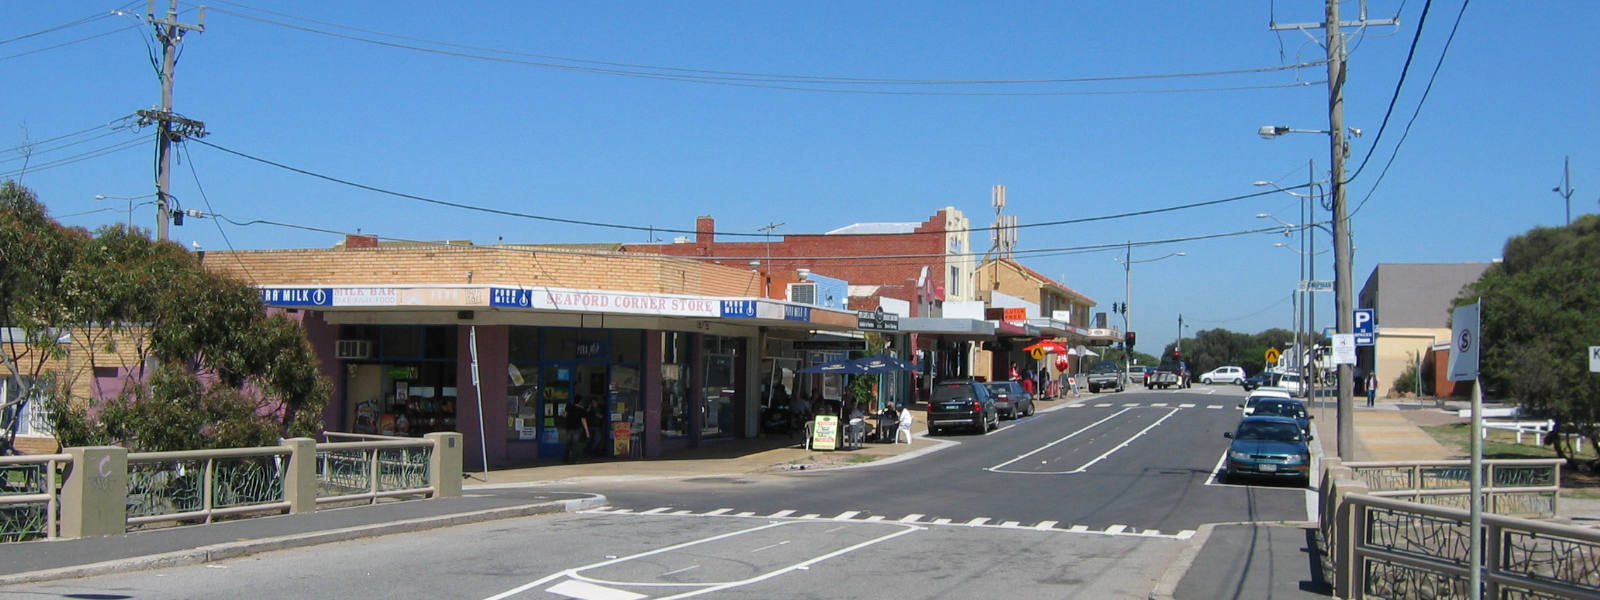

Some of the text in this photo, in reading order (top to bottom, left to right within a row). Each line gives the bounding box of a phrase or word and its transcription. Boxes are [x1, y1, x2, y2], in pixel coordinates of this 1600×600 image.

[282, 290, 309, 301] MILK
[334, 288, 396, 296] MILK BAR
[375, 296, 396, 304] FOOD
[495, 296, 516, 304] MILK
[546, 293, 713, 312] SEAFORD CORNER STORE
[1355, 311, 1370, 328] P
